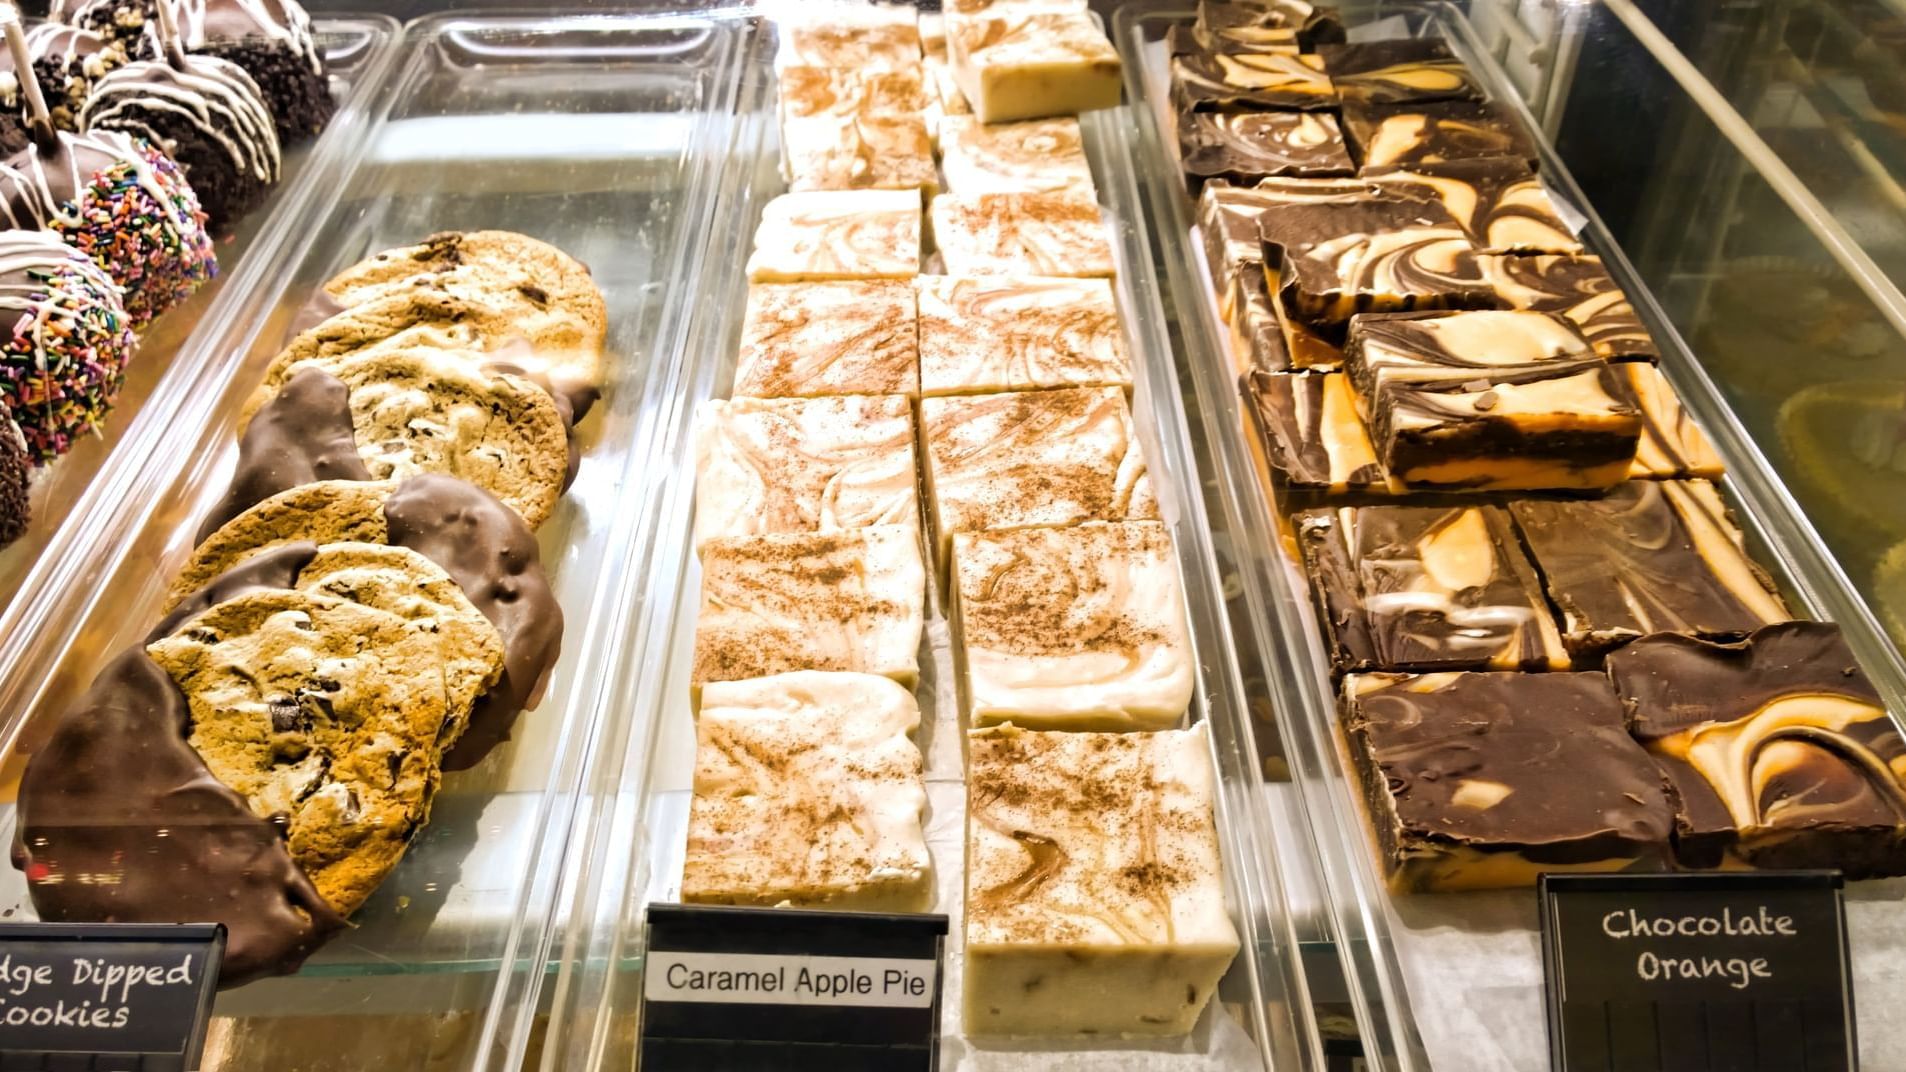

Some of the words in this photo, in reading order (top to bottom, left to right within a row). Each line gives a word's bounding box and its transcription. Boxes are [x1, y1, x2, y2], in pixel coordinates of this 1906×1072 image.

[1602, 906, 1797, 938] Chocolate
[72, 954, 193, 1002] Dipped
[667, 963, 784, 992] Caramel
[794, 967, 872, 997] Apple
[884, 970, 925, 996] Pie
[1637, 952, 1772, 989] Orange
